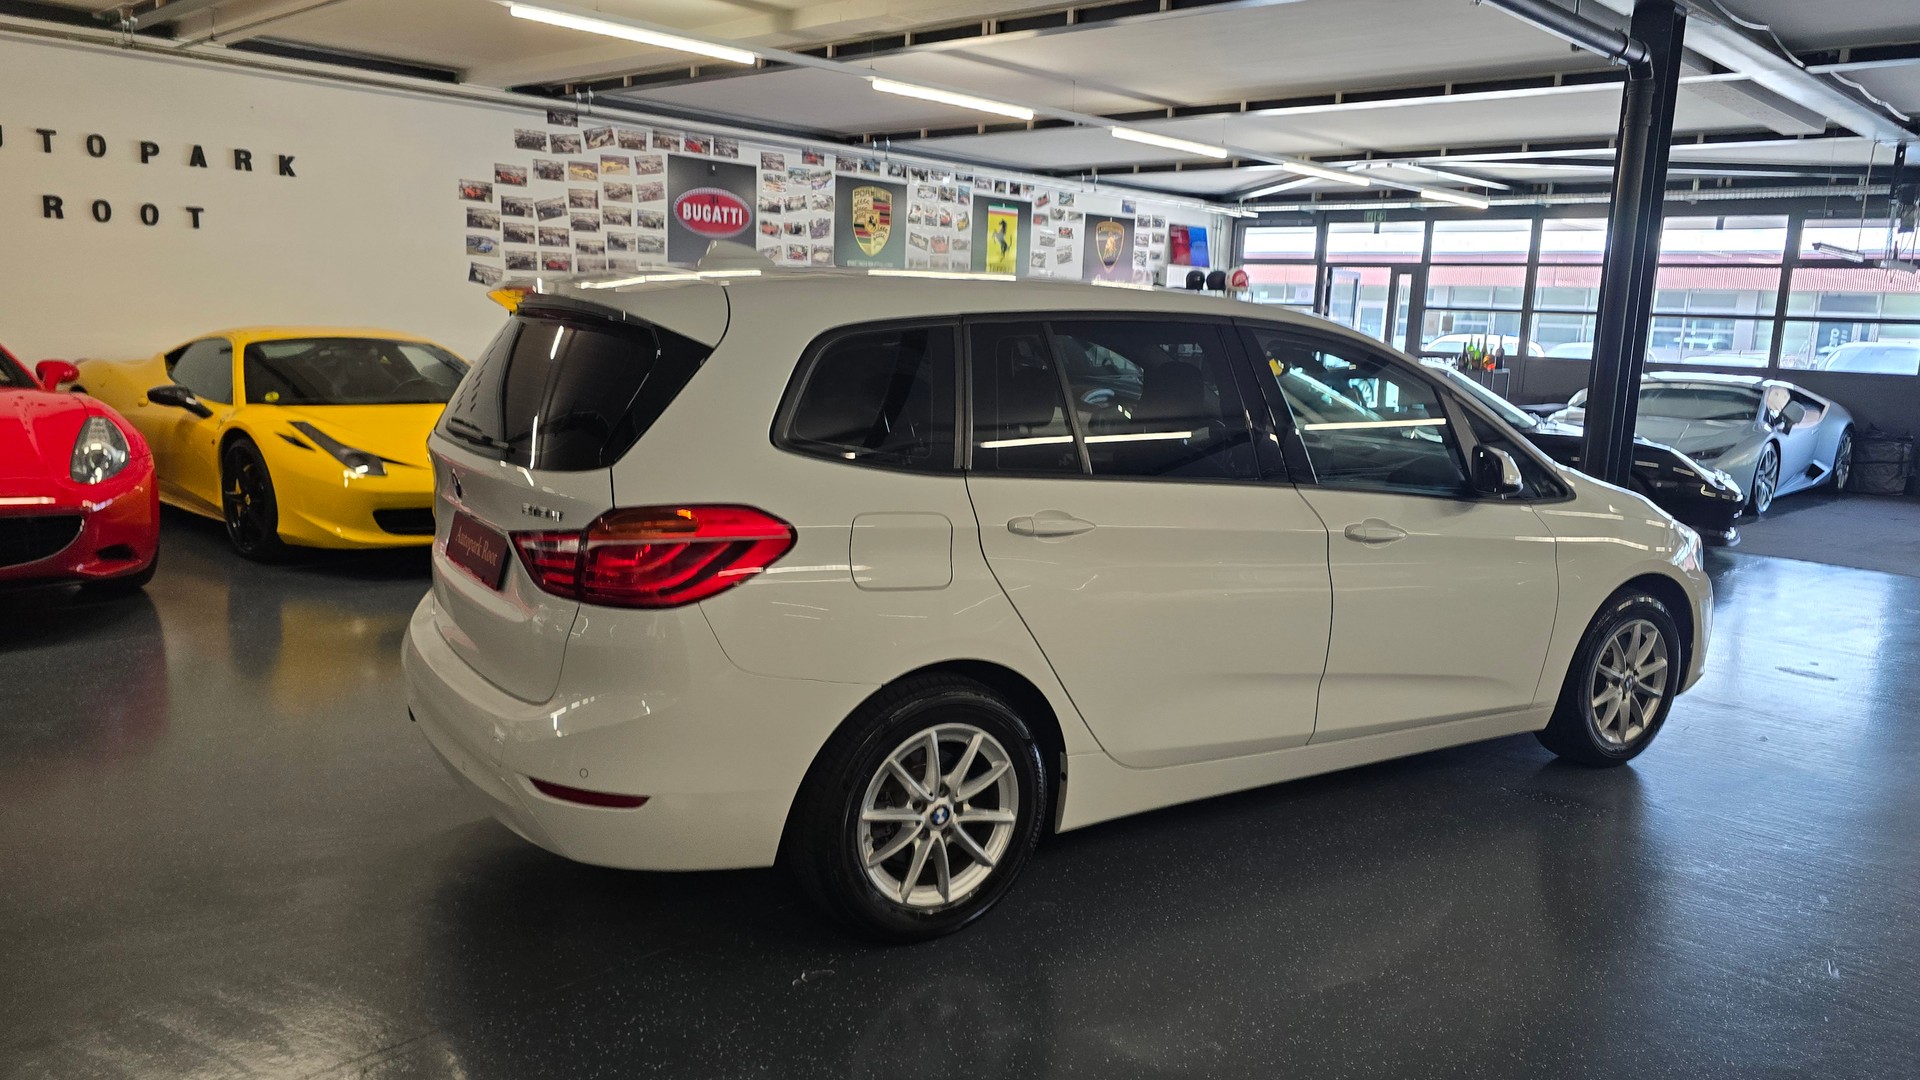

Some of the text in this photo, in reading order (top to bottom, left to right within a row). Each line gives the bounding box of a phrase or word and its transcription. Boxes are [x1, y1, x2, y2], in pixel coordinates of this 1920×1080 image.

[0, 125, 296, 177] TOPARK
[42, 195, 204, 229] ROOT
[682, 202, 743, 226] BUGATTI
[455, 525, 498, 566] Autopark Root
